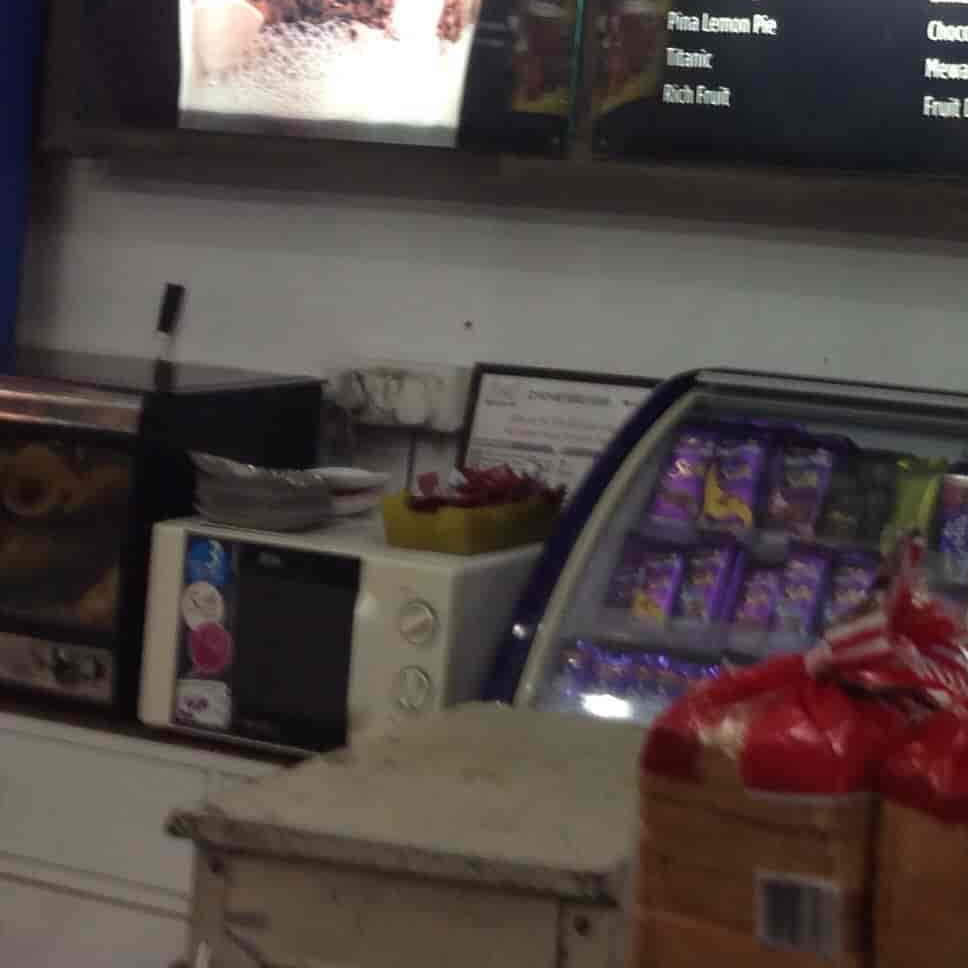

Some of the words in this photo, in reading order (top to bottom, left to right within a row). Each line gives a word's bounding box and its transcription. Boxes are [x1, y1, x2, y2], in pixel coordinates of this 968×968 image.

[666, 11, 701, 32] Pina
[701, 13, 751, 34] Lemon
[751, 14, 778, 36] Pie
[665, 47, 713, 70] Titanic
[662, 83, 695, 105] Rich
[695, 84, 731, 108] Fruit
[922, 95, 961, 119] Fruit
